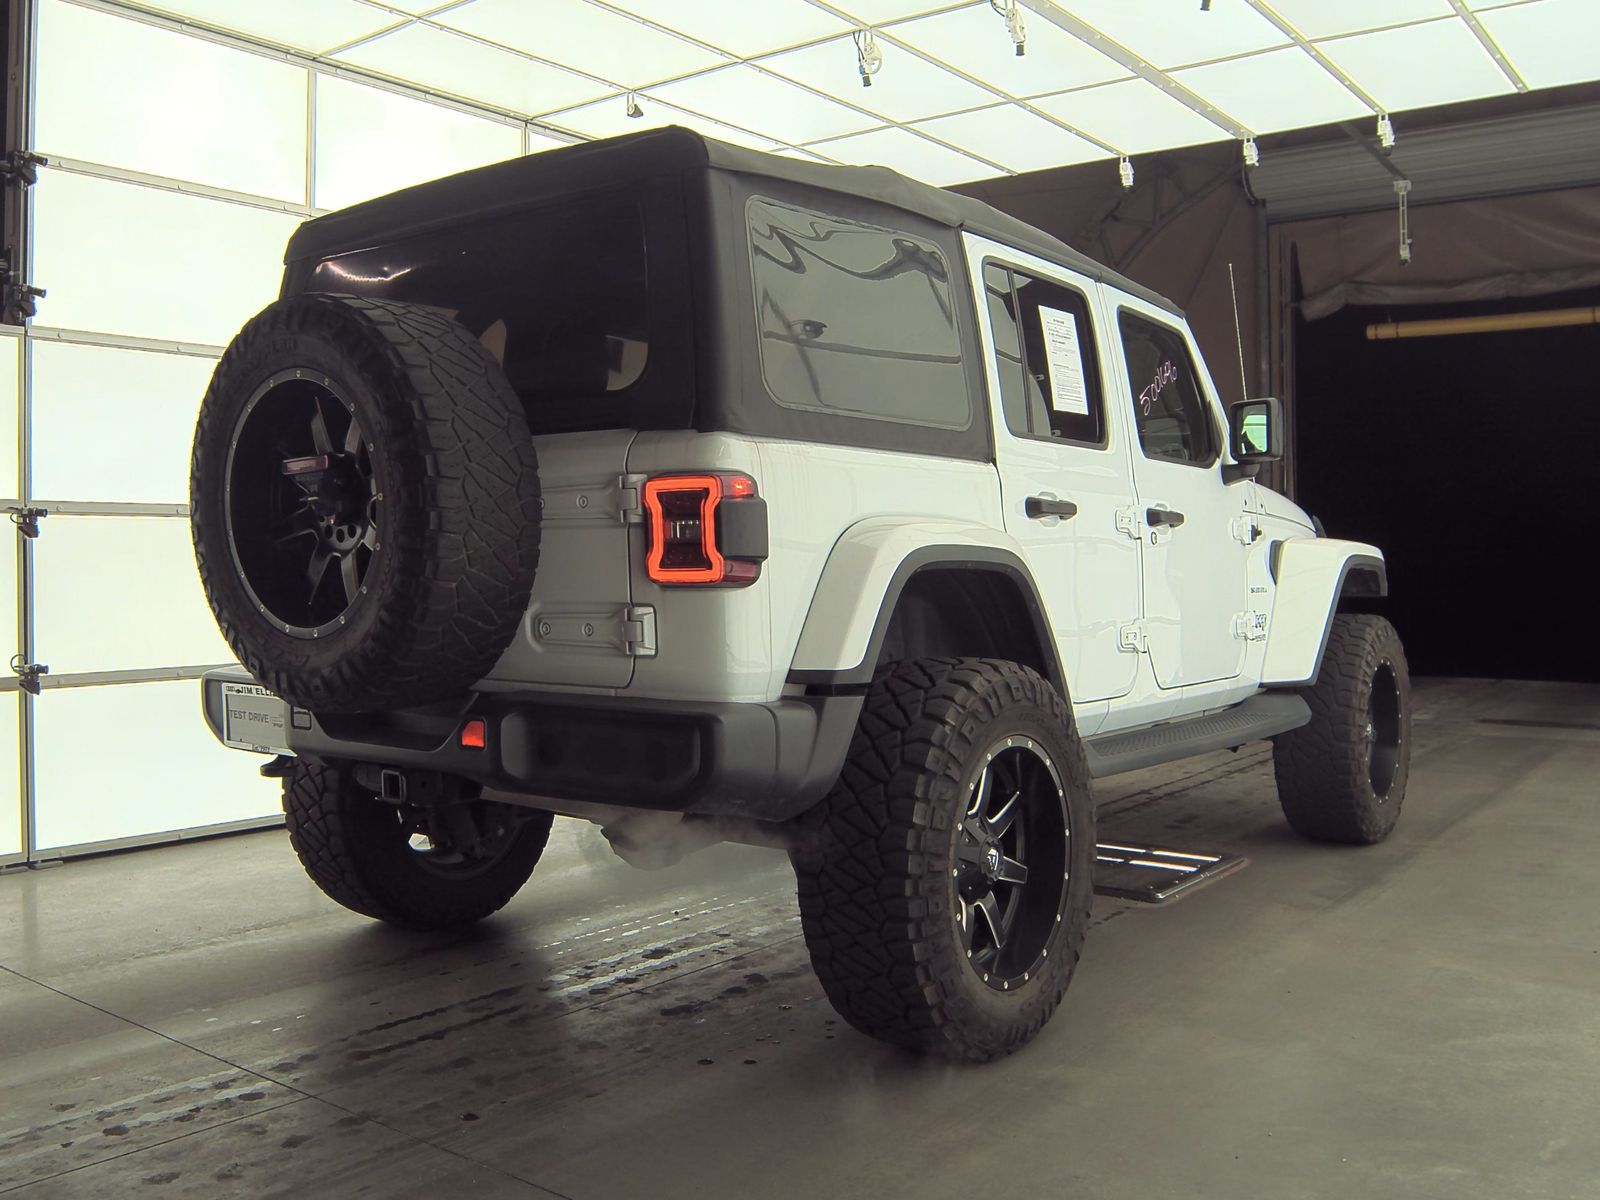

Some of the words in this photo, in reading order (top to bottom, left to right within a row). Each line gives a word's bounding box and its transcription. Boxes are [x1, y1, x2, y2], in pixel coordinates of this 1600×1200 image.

[240, 686, 253, 695] JIM
[229, 709, 246, 720] TEST
[248, 711, 269, 723] DRIVE
